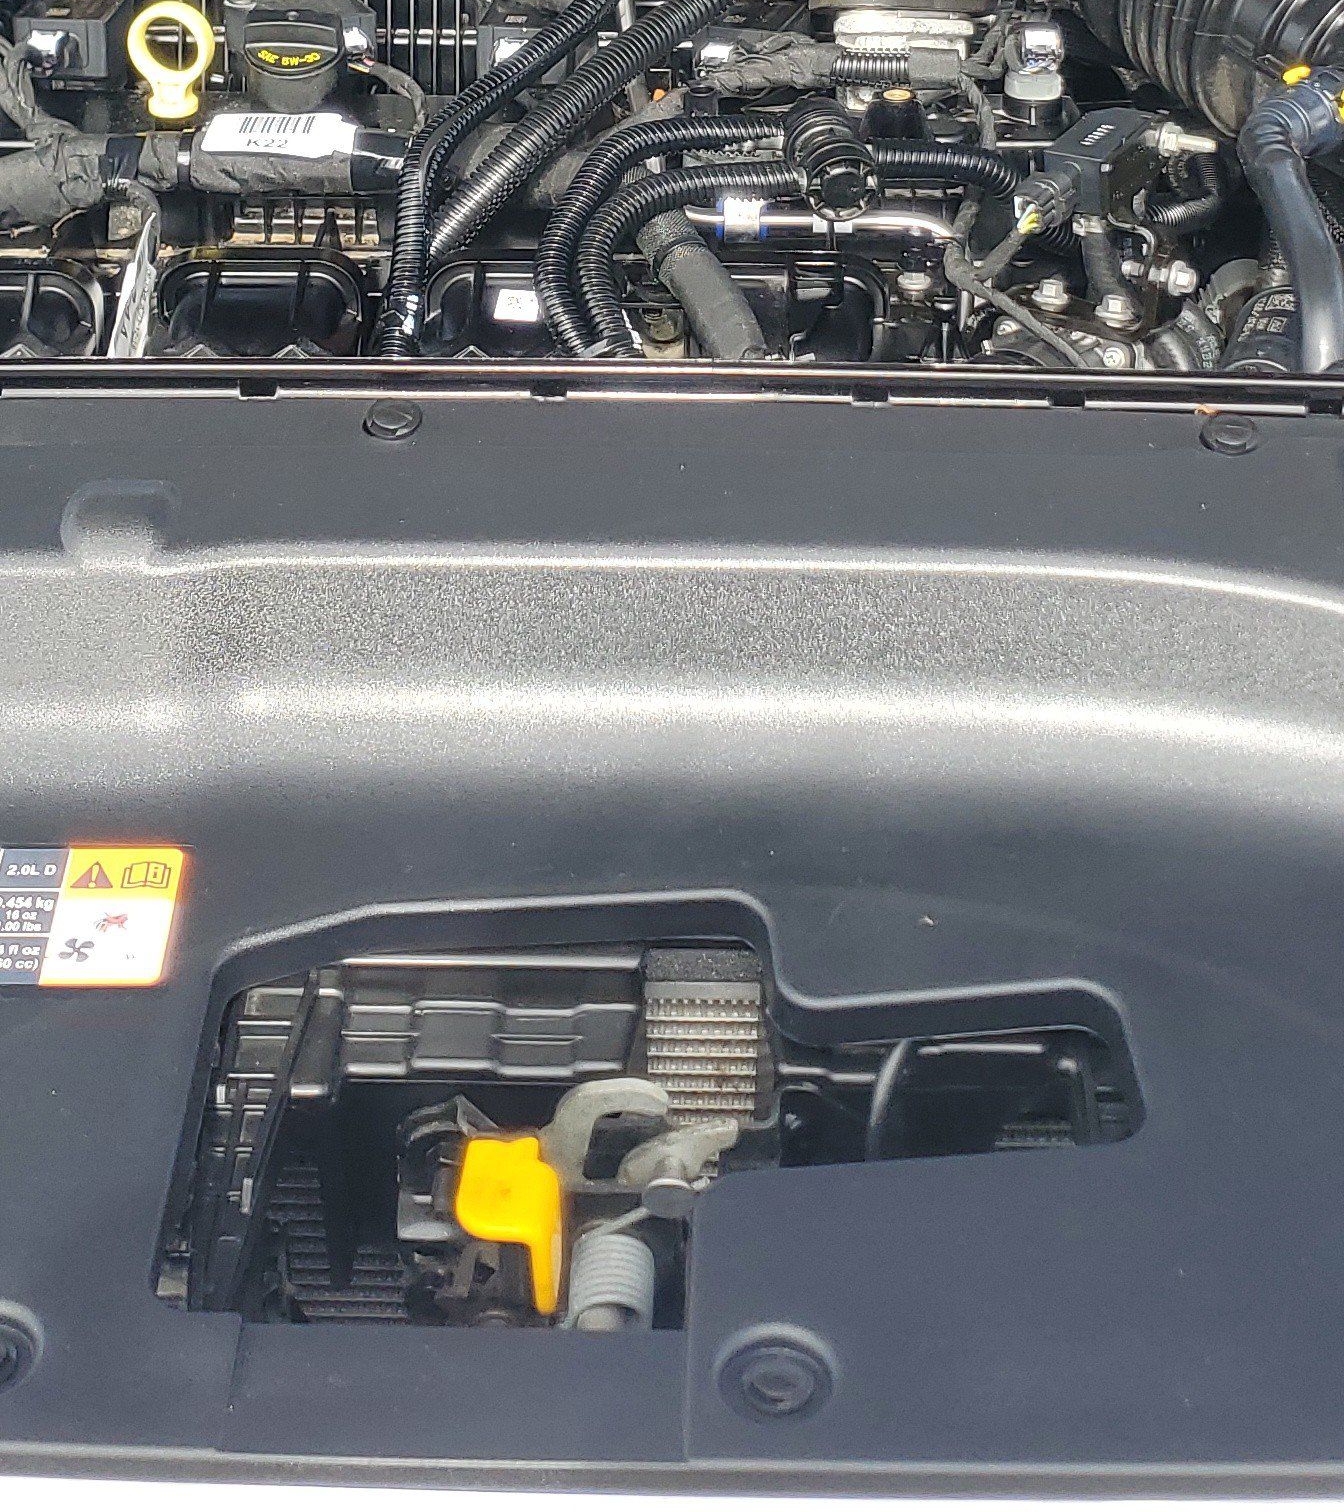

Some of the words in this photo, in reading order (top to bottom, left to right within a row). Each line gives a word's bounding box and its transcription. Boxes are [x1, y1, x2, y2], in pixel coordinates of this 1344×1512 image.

[257, 50, 280, 64] SAE
[7, 864, 40, 876] 2.0L
[44, 865, 57, 875] D
[36, 897, 54, 911] kg
[6, 910, 19, 920] 16
[22, 912, 38, 920] oz
[22, 922, 41, 931] lbs
[9, 944, 19, 955] fl
[22, 946, 40, 955] oz
[15, 959, 38, 971] cc)
